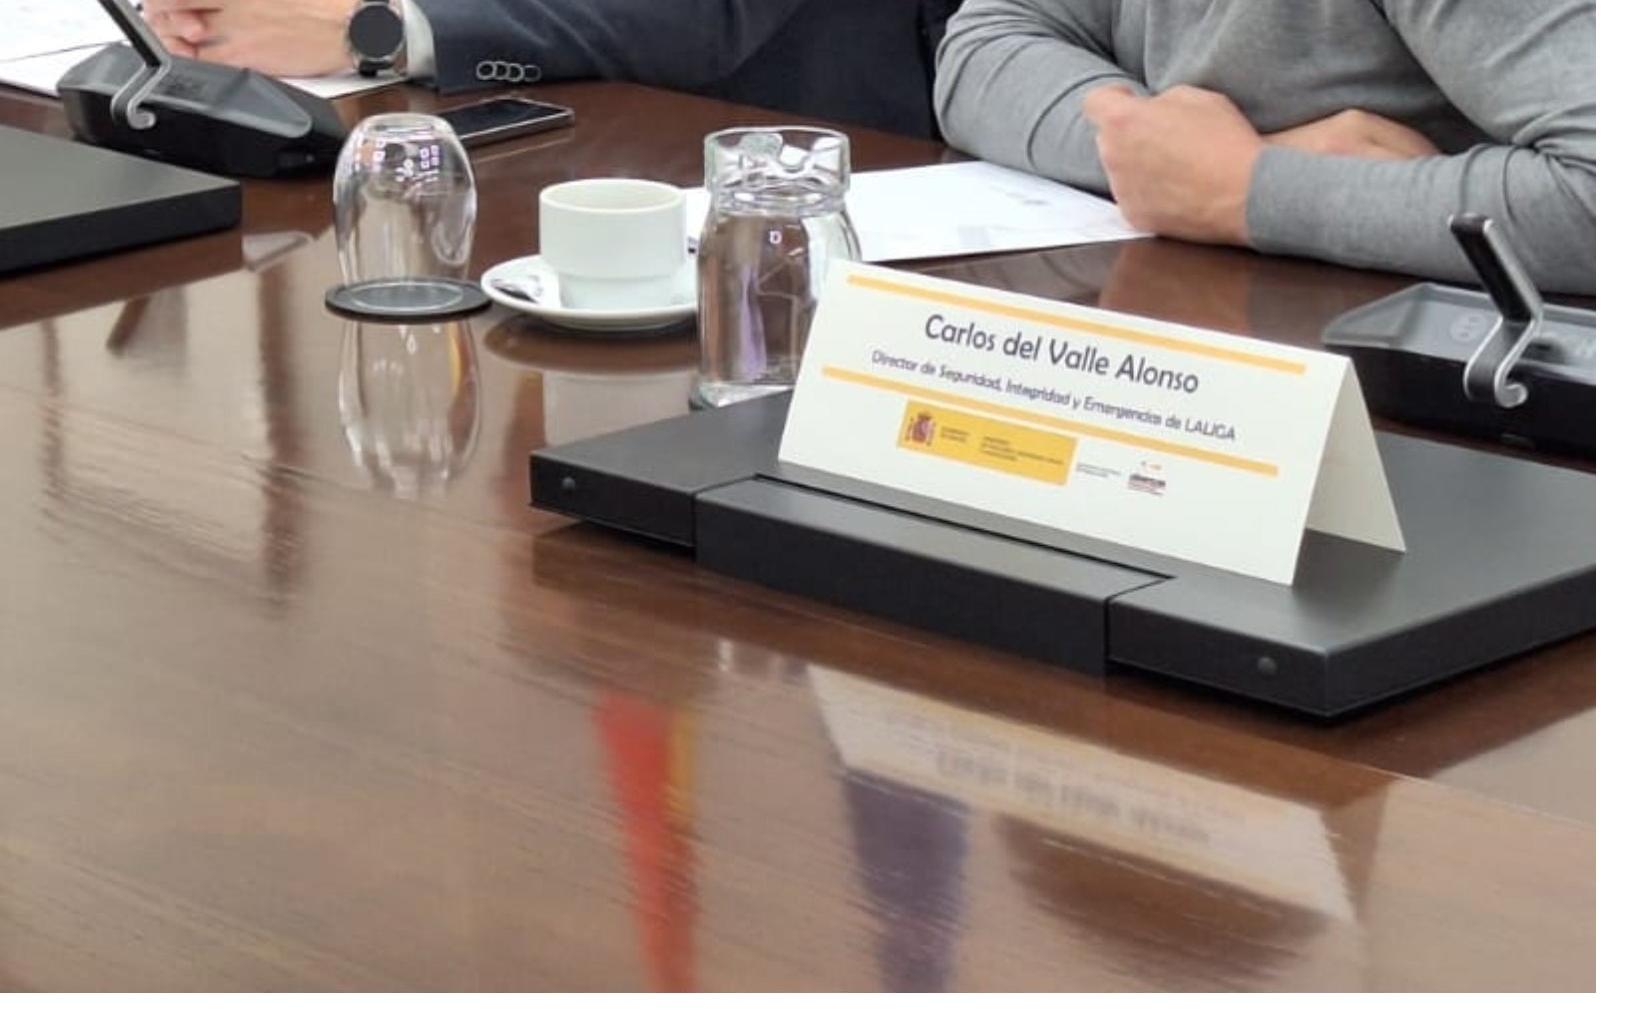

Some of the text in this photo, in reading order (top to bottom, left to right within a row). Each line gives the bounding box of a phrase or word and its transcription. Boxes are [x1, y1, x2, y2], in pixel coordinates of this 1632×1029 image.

[871, 349, 917, 371] Director
[920, 362, 936, 376] de
[938, 365, 1002, 392] Seguridad,
[1005, 380, 1070, 405] Integridad
[1072, 398, 1080, 410] y
[1165, 414, 1182, 429] de
[925, 314, 1199, 394] Carlos del Valle Alonso
